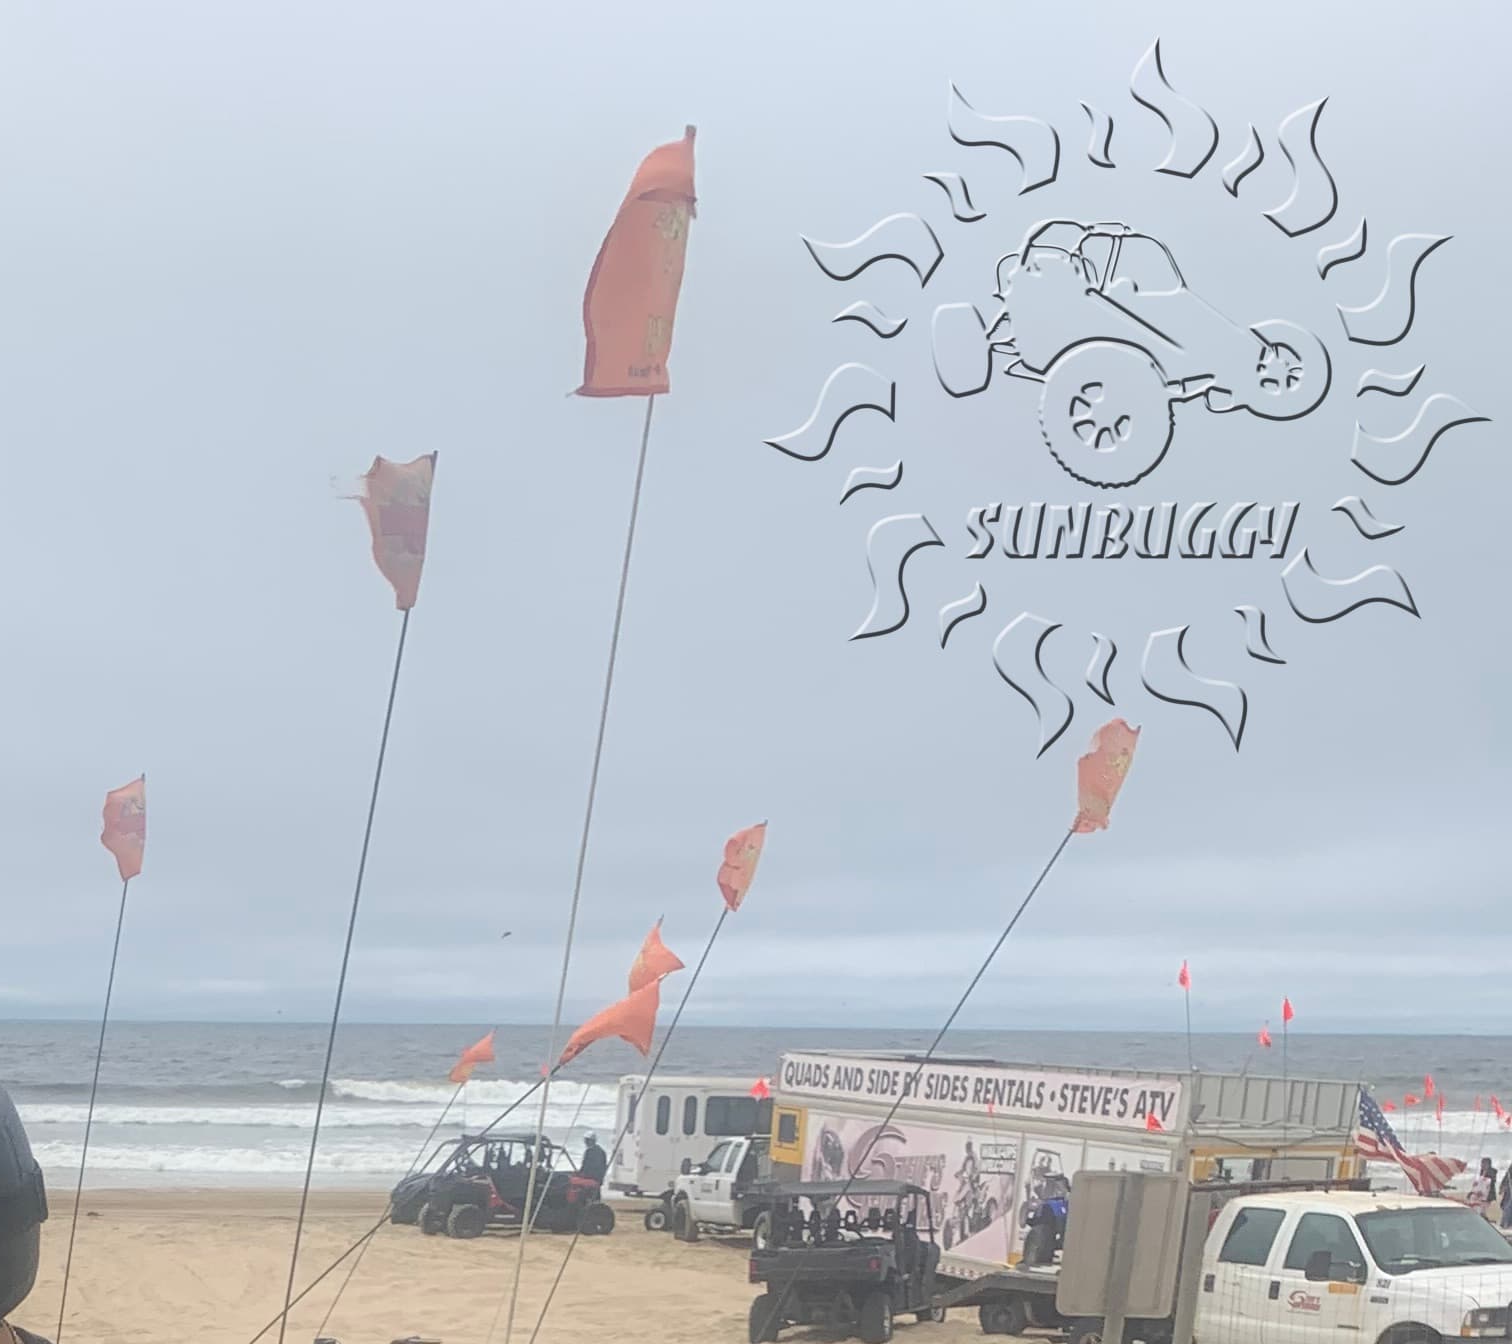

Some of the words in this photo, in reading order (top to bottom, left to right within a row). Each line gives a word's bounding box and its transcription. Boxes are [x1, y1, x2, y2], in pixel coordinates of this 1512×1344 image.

[784, 1061, 830, 1088] QUADS
[832, 1065, 864, 1091] AND
[867, 1068, 898, 1096] SIDE
[903, 1071, 923, 1098] BY
[925, 1073, 970, 1103] SIDES
[972, 1076, 1046, 1110] RENTALS
[1057, 1083, 1129, 1118] STEVE'S
[1133, 1089, 1175, 1122] ATV
